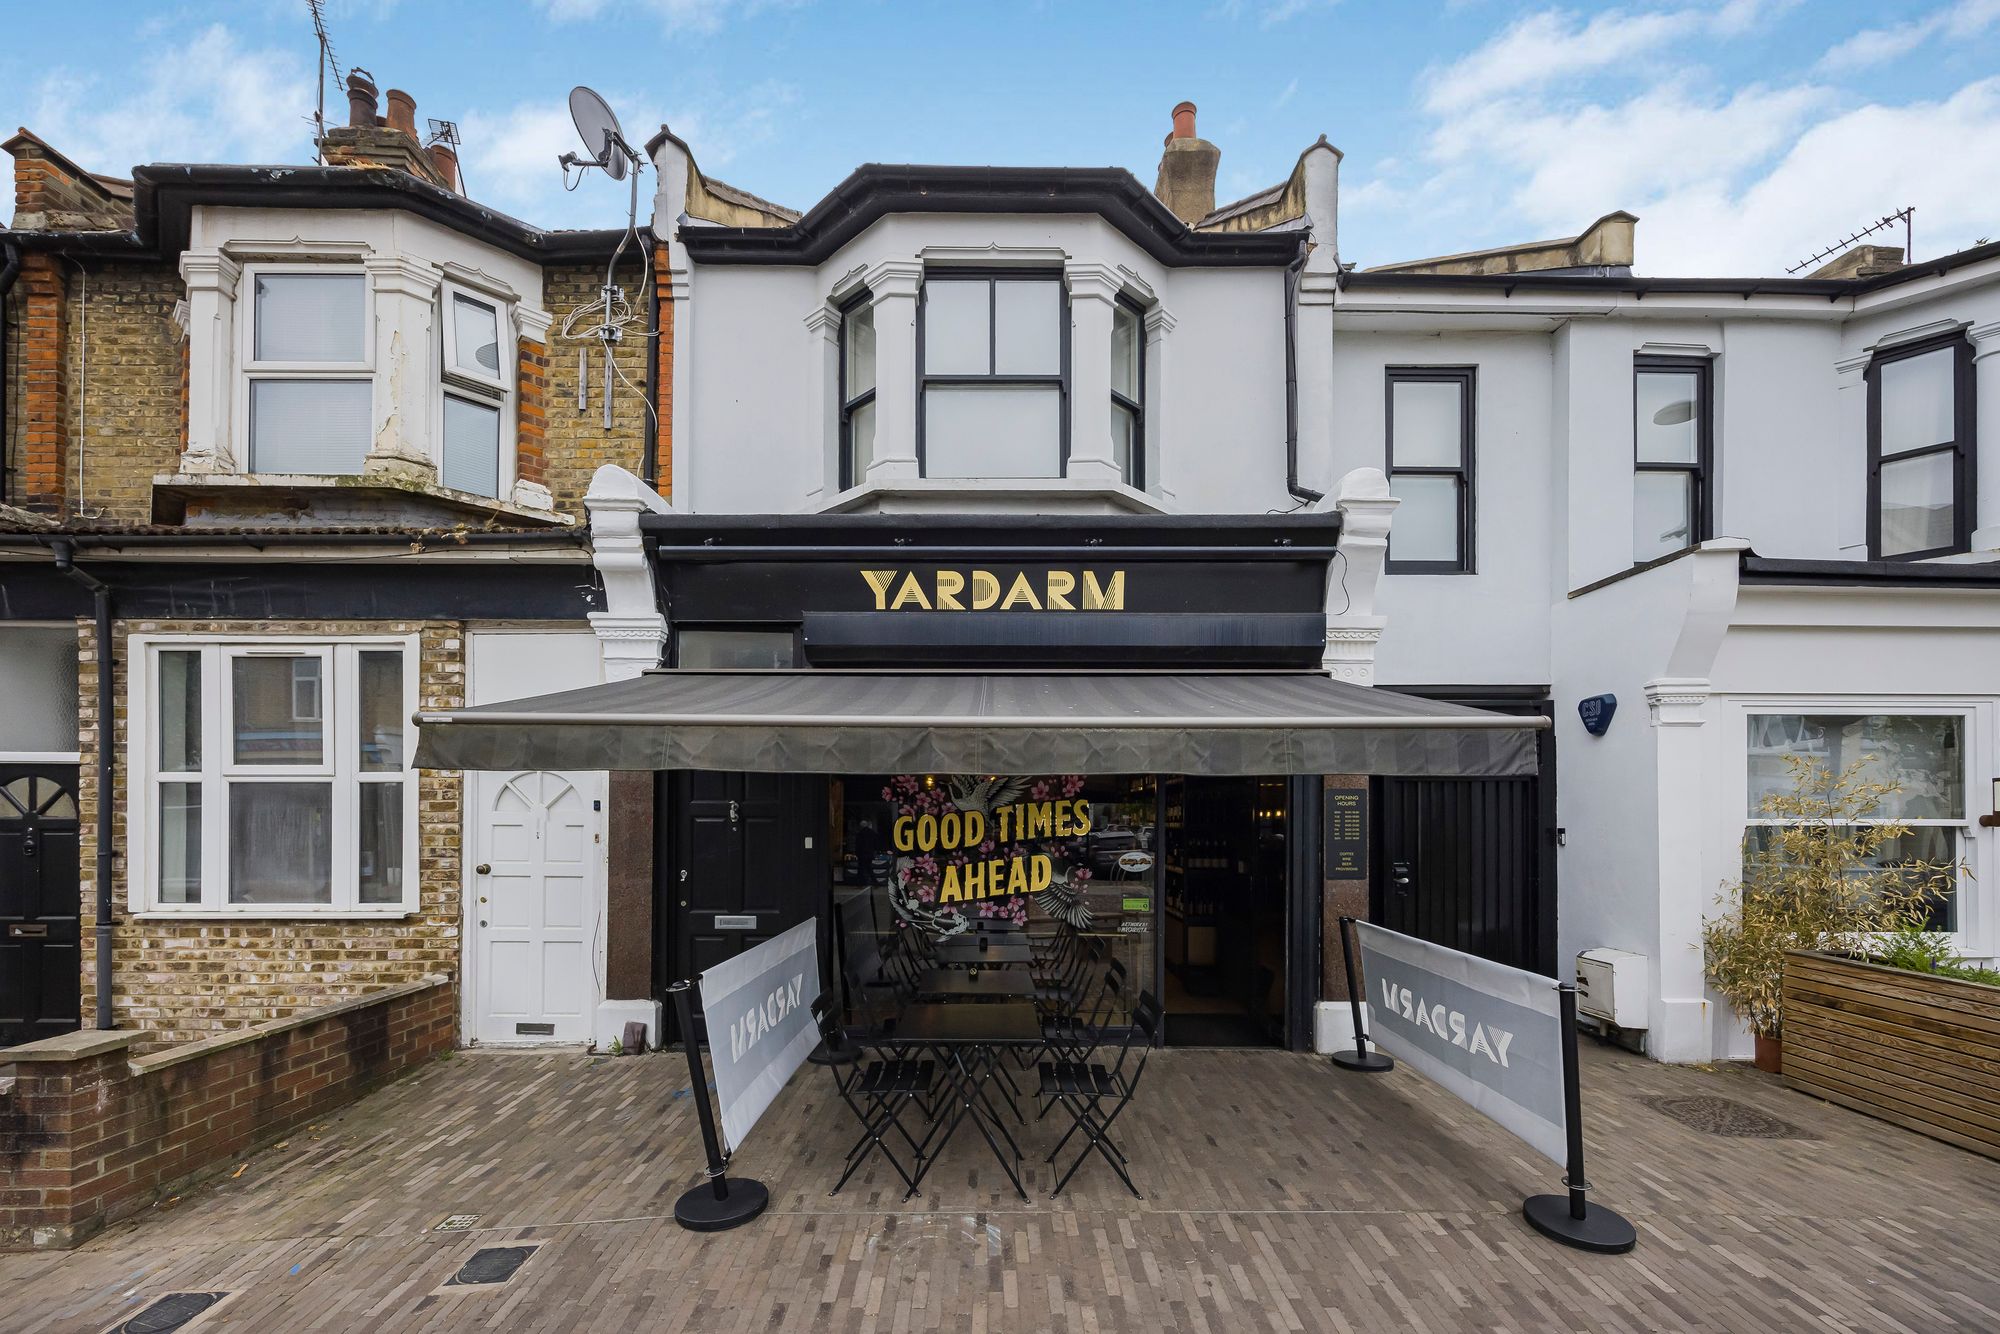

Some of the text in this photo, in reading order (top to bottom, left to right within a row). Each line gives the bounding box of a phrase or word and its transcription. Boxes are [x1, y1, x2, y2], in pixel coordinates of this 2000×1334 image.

[860, 570, 1125, 611] YARDARM
[893, 799, 1091, 852] GOOD TIMES
[939, 854, 1052, 903] AHEAD
